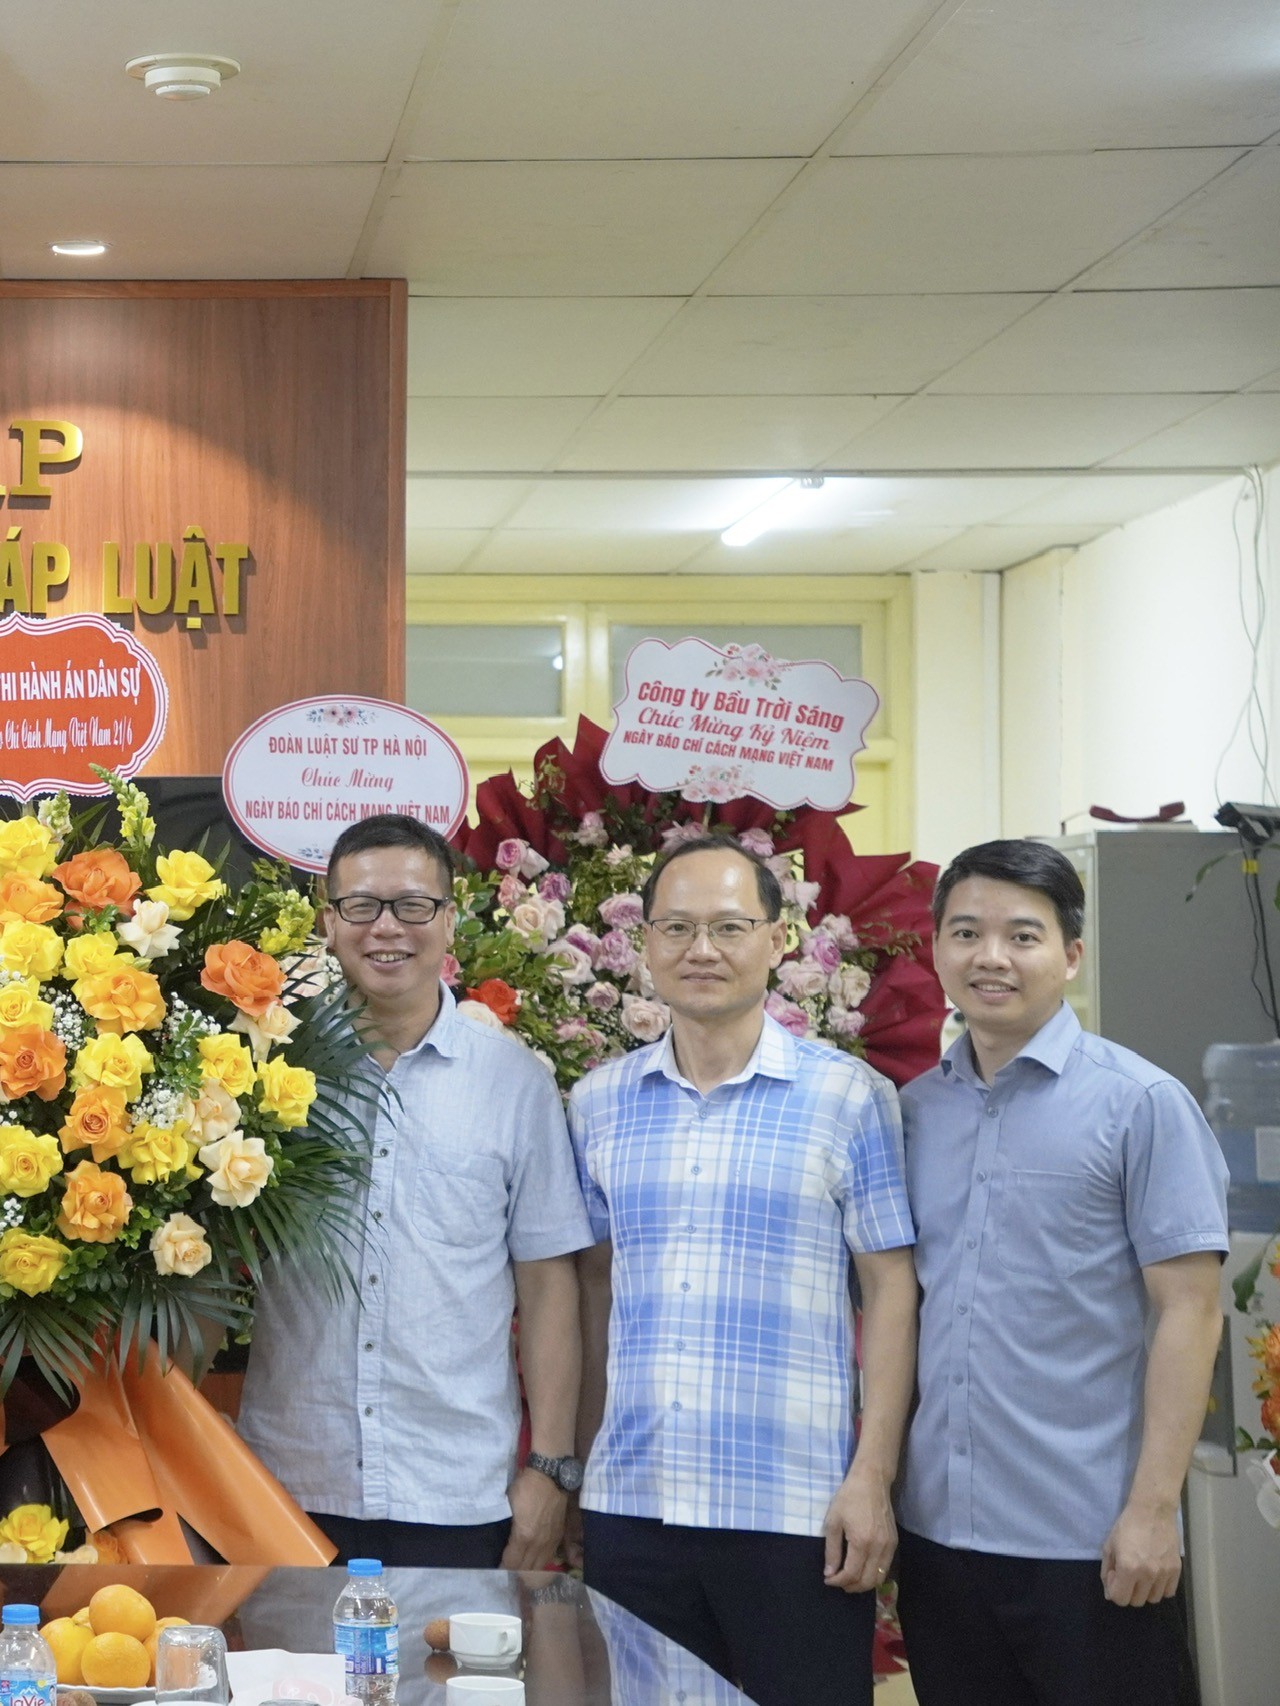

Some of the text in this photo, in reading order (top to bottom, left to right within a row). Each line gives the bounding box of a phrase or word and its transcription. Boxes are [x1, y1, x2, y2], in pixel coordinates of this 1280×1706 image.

[102, 525, 250, 630] LUẬT
[19, 662, 61, 701] HÀNH
[64, 660, 86, 699] ÁN
[88, 659, 118, 698] DÂN
[120, 660, 141, 705] SỰ
[637, 680, 845, 733] Công ty Bầu Trời Sáng
[5, 718, 19, 750] Chí
[21, 718, 41, 750] Cách
[43, 717, 67, 755] Mạng
[68, 716, 88, 753] Việt
[89, 716, 111, 747] Nam
[113, 715, 133, 753] 21/6
[268, 732, 428, 760] ĐOÀN LUẬT SƯ TP HÀ NỘI
[623, 729, 835, 771] NGÀY BÁO CHÍ CÁCH MẠNG VIỆT NAM
[637, 706, 831, 752] Chúc Mừng Kỷ Niệm
[301, 767, 394, 792] Chúc Mừng
[245, 796, 274, 819] NGÀY
[277, 797, 300, 820] BÁO
[303, 797, 322, 821] CHÍ
[326, 798, 357, 821] CÁCH
[424, 805, 450, 824] NAM
